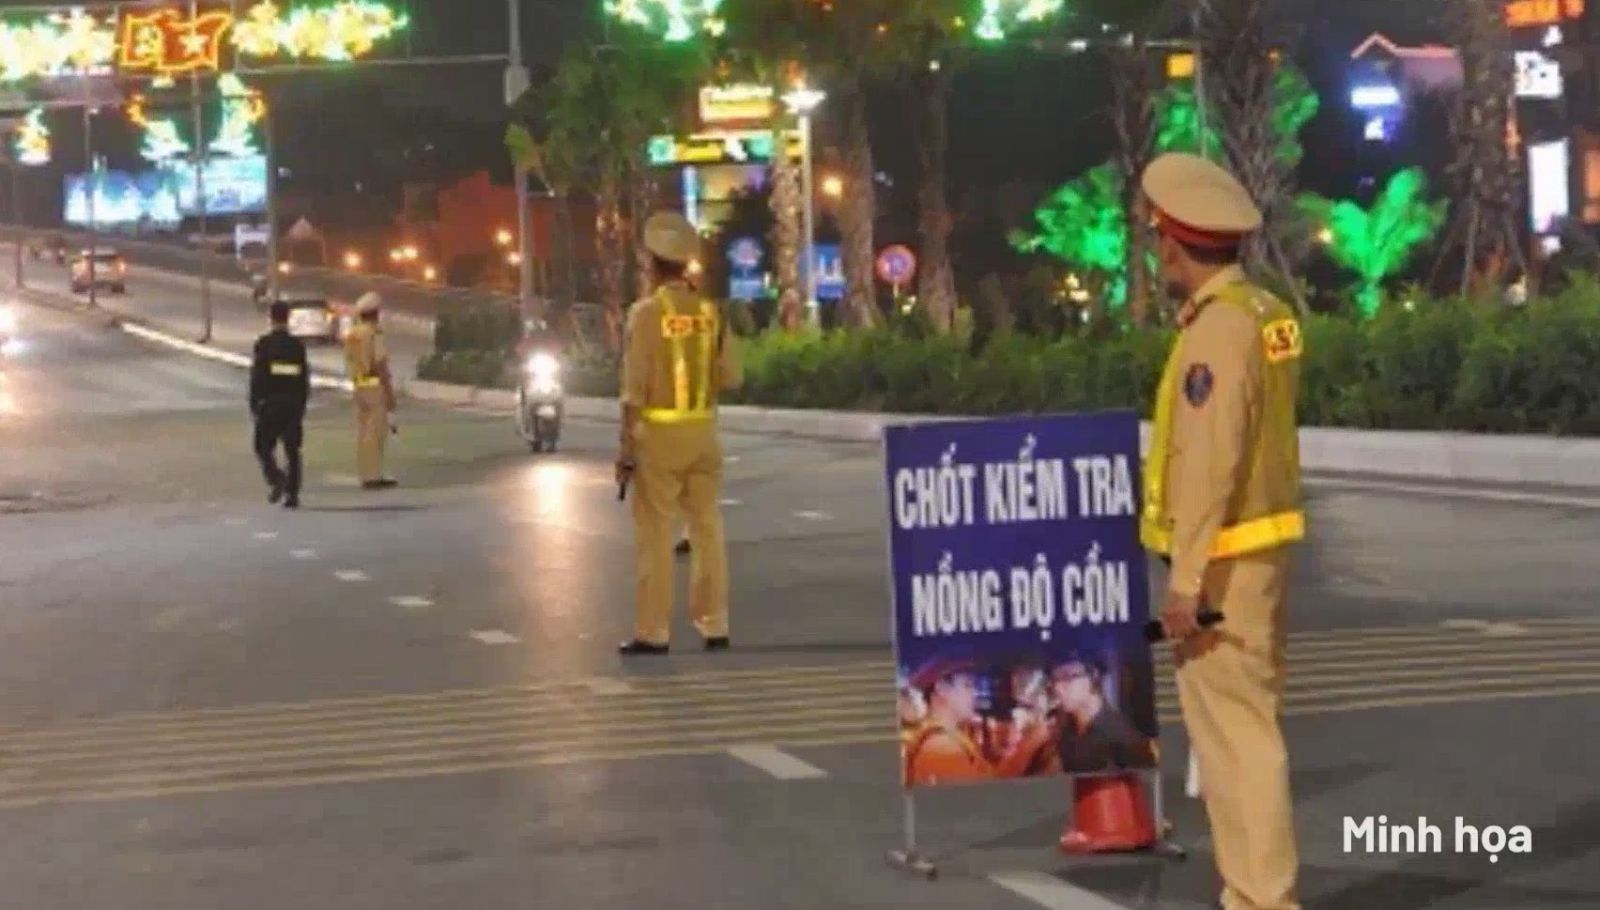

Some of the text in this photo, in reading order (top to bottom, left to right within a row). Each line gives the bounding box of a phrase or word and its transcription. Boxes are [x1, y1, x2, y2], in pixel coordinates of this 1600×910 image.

[895, 433, 1135, 529] CHỐT KIỂM TRA
[911, 540, 1130, 641] NỒNG ĐỘ CỒN
